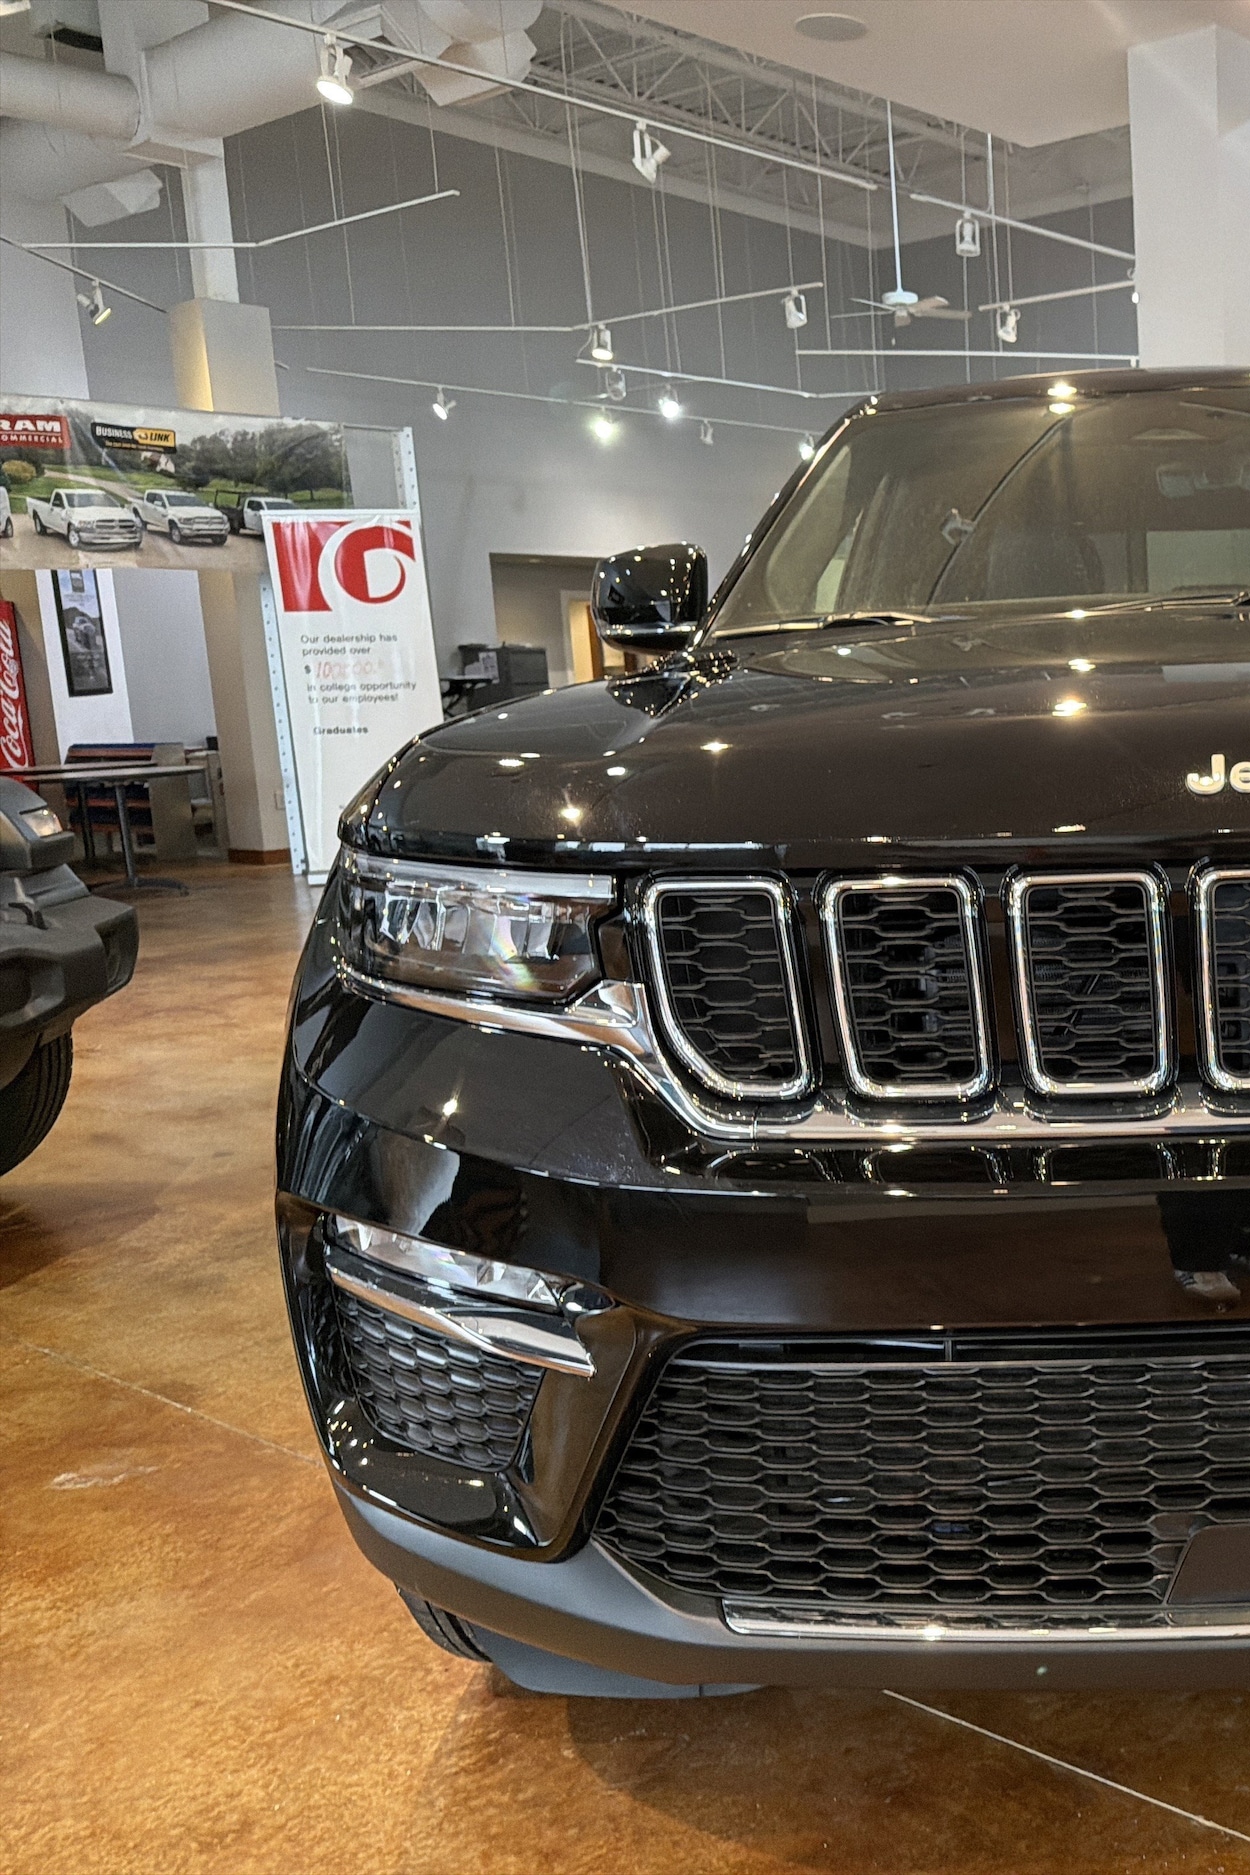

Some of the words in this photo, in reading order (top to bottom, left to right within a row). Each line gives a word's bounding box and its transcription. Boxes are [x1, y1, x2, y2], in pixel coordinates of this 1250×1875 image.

[0, 419, 61, 432] RAM
[0, 434, 63, 443] OMMERCIAL
[95, 425, 132, 440] BUSINESS
[150, 432, 170, 442] LINK
[300, 634, 319, 644] Our
[323, 633, 376, 645] dealership
[379, 633, 398, 642] has
[302, 646, 346, 657] provided
[349, 647, 371, 655] over
[319, 682, 356, 693] college
[360, 681, 417, 692] opportunity
[321, 695, 338, 704] our
[313, 726, 369, 735] Graduates
